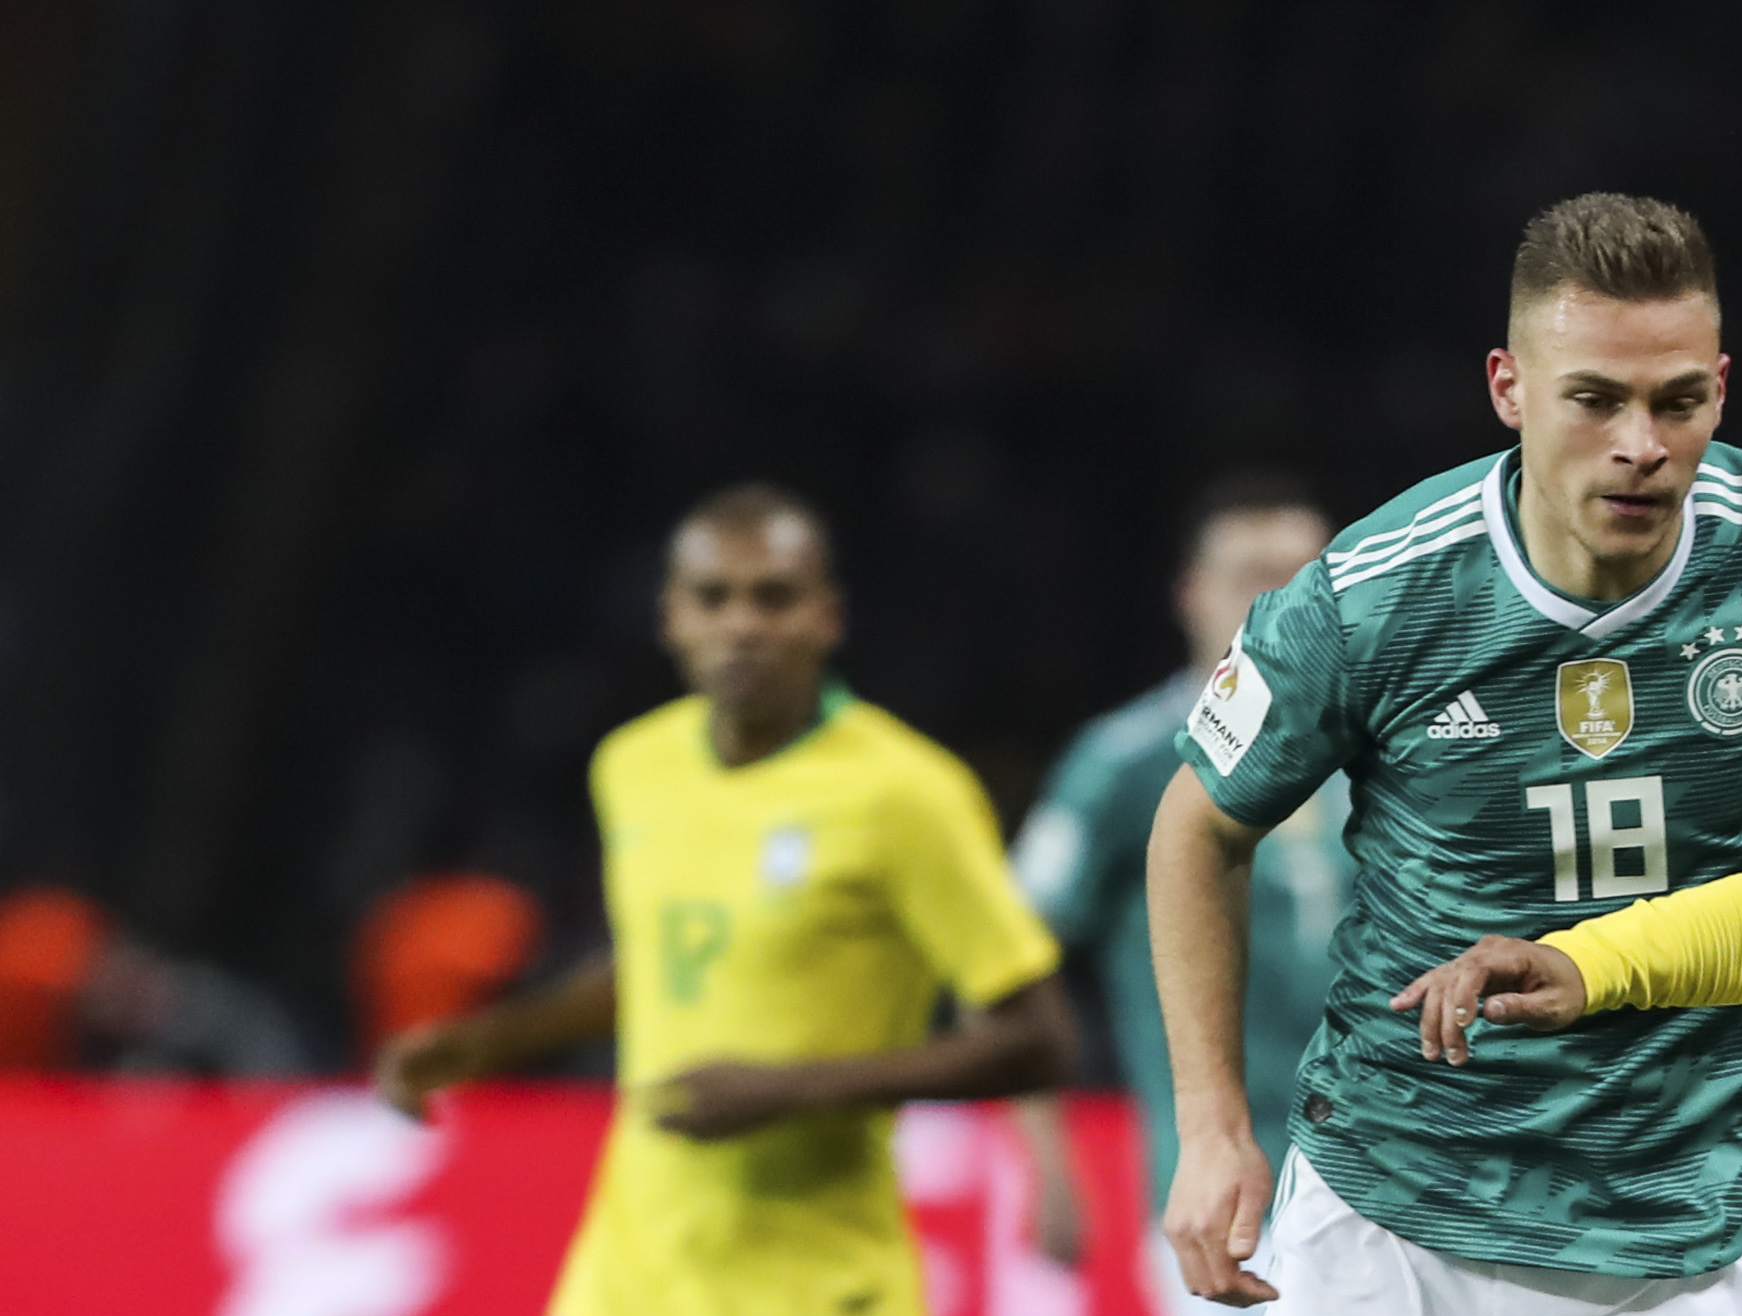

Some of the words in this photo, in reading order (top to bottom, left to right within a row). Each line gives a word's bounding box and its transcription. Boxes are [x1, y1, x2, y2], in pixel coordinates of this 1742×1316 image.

[1201, 692, 1244, 751] RMANY
[1427, 721, 1501, 739] adidas
[1579, 720, 1614, 733] FIFA
[1526, 775, 1669, 902] 18
